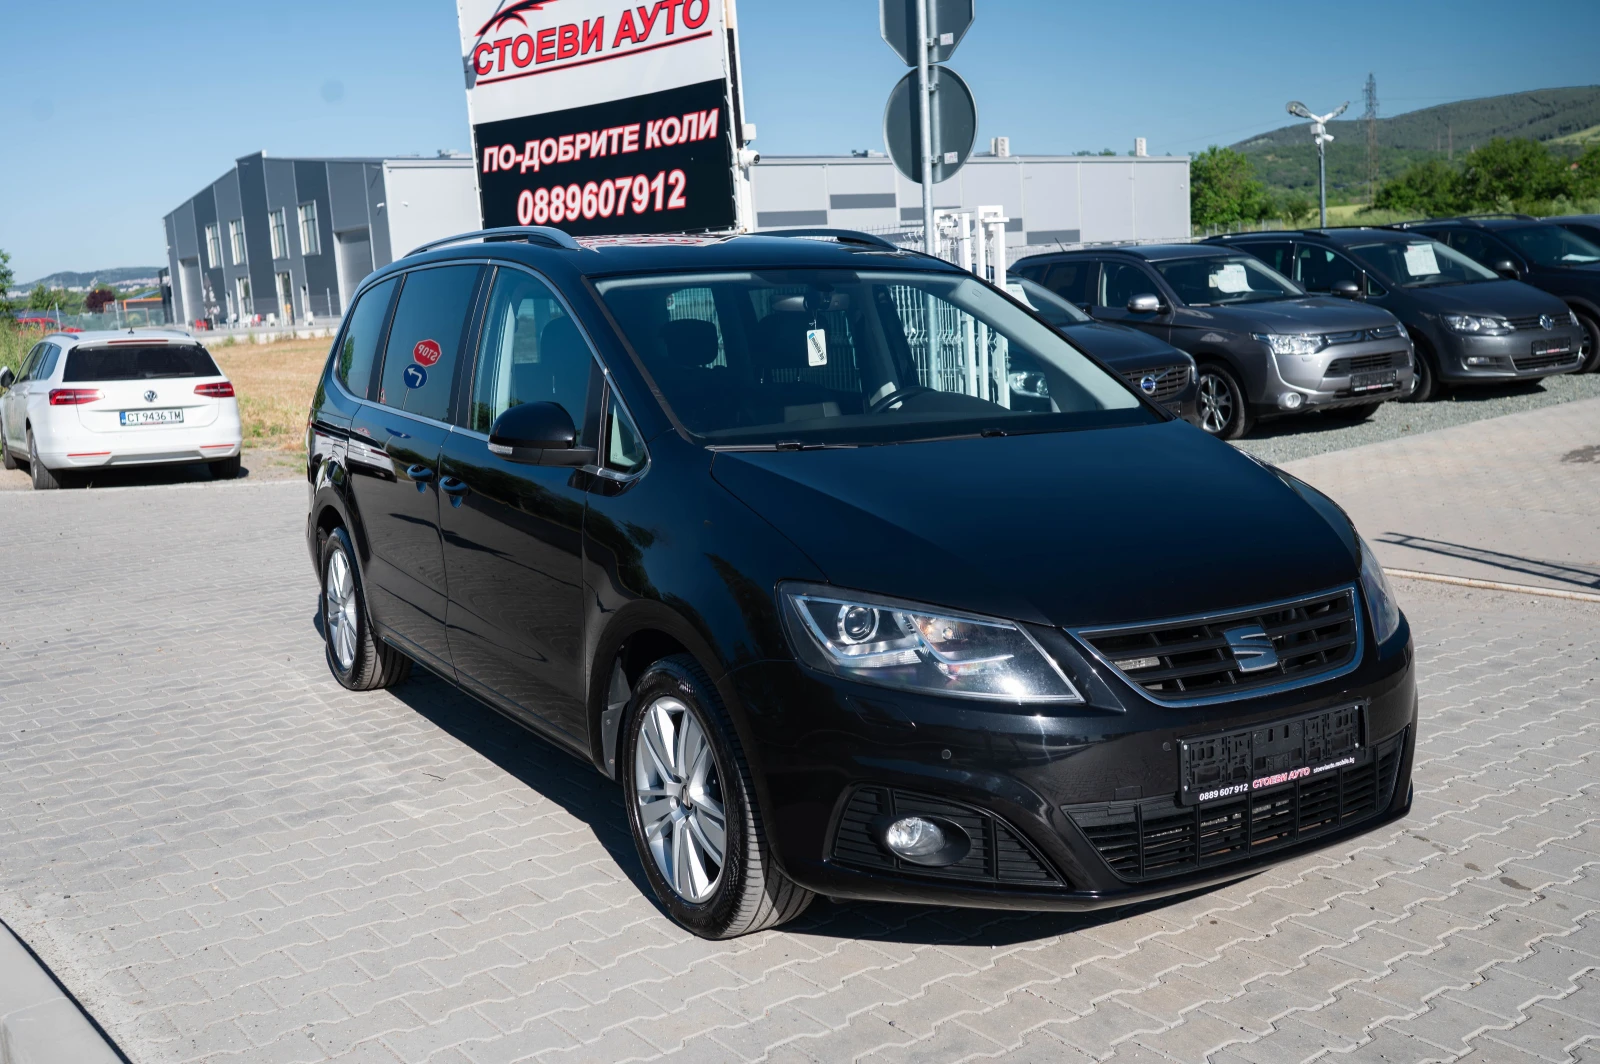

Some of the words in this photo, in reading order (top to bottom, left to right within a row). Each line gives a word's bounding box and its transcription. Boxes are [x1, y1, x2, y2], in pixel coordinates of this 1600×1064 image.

[473, 16, 604, 76] СТОЕВИ
[612, 0, 710, 48] АУТО
[482, 123, 640, 174] ПО-ДОБРИТЕ
[644, 108, 720, 149] КОЛИ
[517, 168, 687, 227] 0889607912
[142, 411, 167, 422] 9436
[1199, 790, 1219, 801] 0889
[1219, 786, 1234, 797] 607
[1234, 783, 1249, 794] 912
